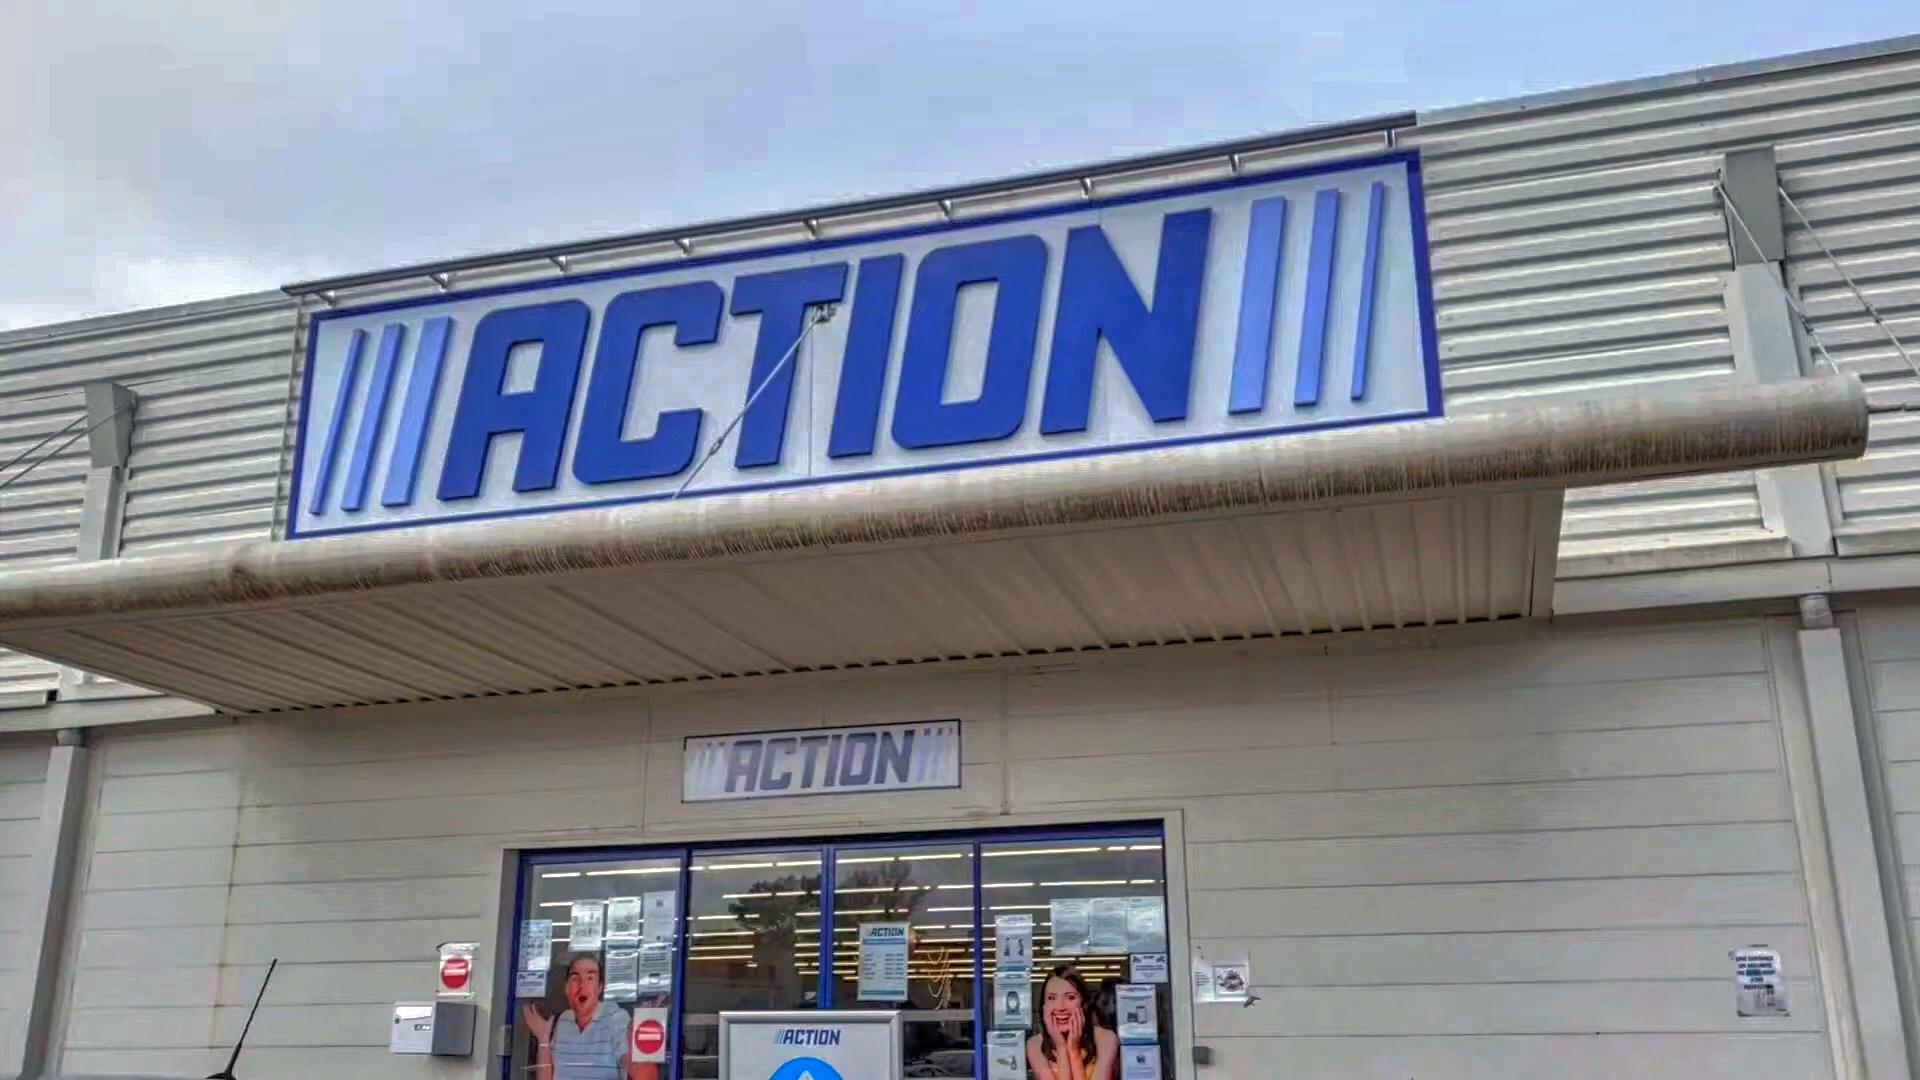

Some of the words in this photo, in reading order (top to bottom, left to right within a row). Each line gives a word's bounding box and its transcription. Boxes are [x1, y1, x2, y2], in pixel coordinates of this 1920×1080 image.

[436, 207, 1212, 500] ACTION
[724, 729, 916, 792] ACTION
[870, 927, 904, 937] ACTION
[782, 1029, 841, 1045] ACTION
